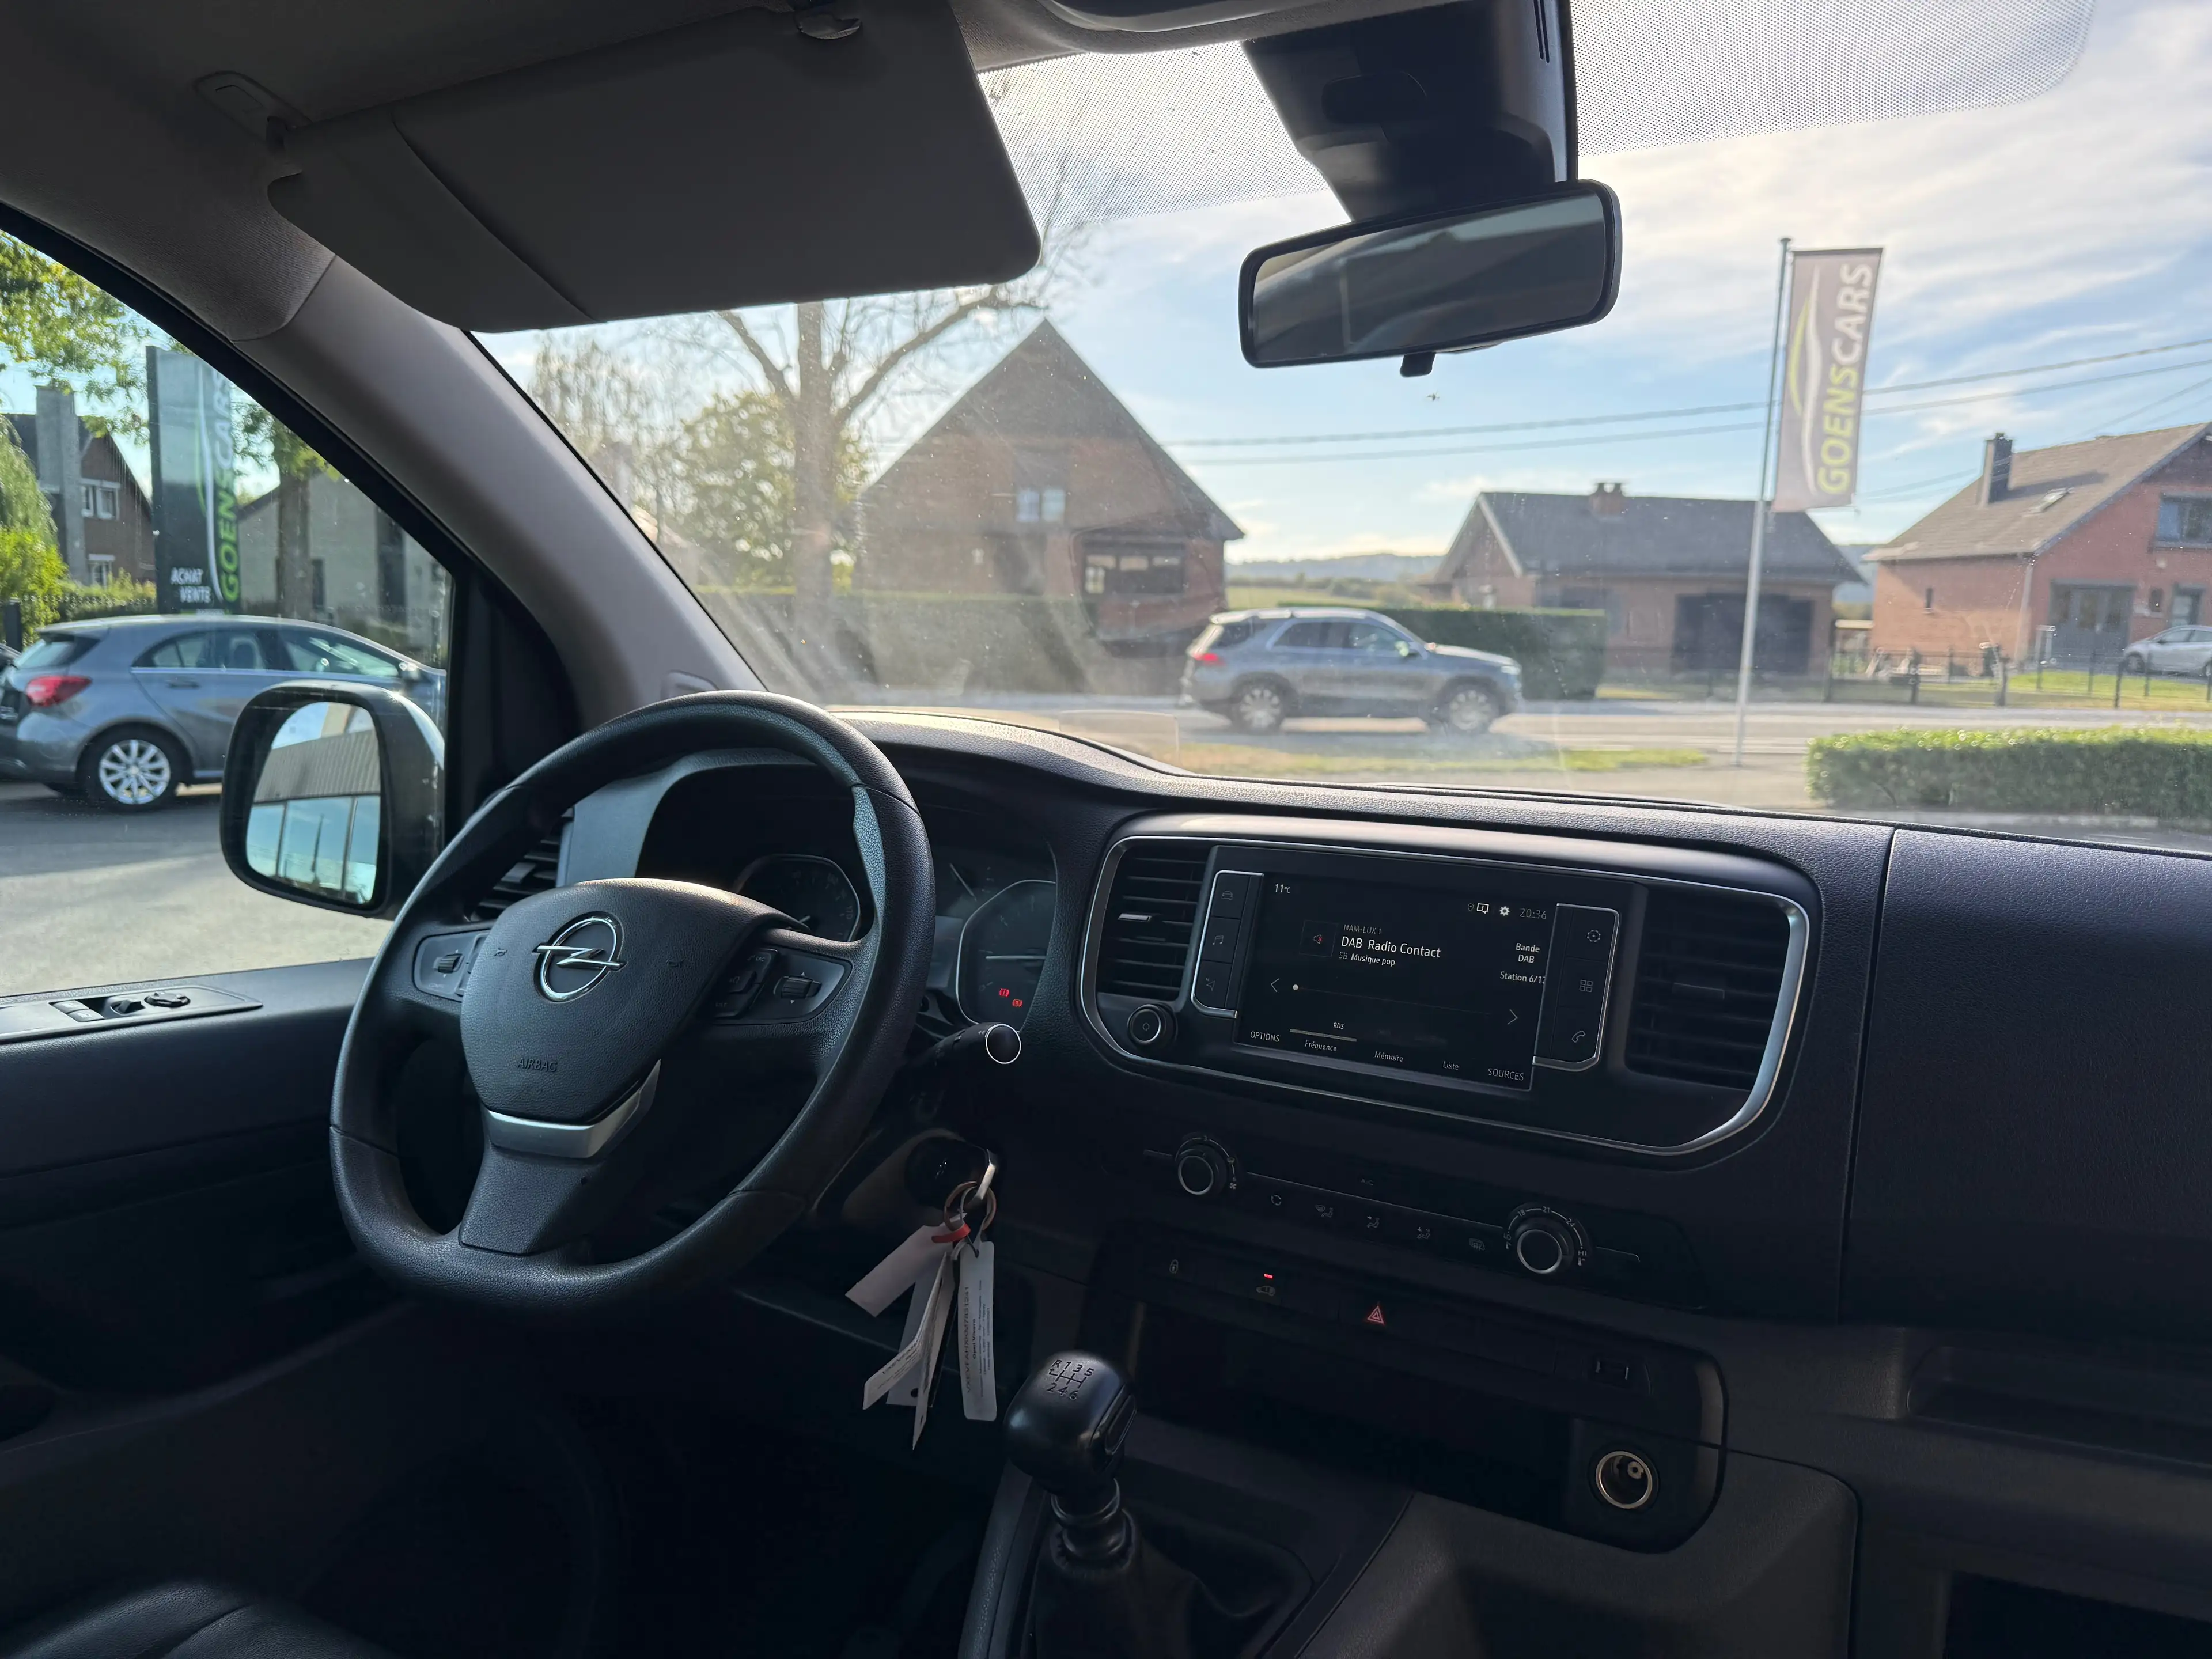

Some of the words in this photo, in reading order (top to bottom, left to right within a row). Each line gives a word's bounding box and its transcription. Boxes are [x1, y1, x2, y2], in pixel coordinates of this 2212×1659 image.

[1818, 263, 1873, 494] GOENSCARS
[1519, 908, 1547, 919] 20:36
[1343, 924, 1376, 934] NAM-LUX
[1341, 936, 1363, 949] DAB
[1368, 939, 1397, 953] Radio
[1400, 942, 1441, 958] Contact
[1516, 942, 1540, 953] Bande
[1351, 953, 1381, 964] Musique
[1381, 958, 1396, 966] pop
[1518, 954, 1535, 963] DAB
[1499, 971, 1527, 982] Station
[1249, 1031, 1280, 1042] OPTIONS
[1304, 1040, 1337, 1052] Fréquence
[1374, 1050, 1404, 1062] Mémoire
[517, 1059, 558, 1072] AIRBAG
[1442, 1060, 1460, 1071] Liste
[1487, 1067, 1524, 1081] SOURCES
[1542, 1206, 1551, 1214] 21
[1566, 1218, 1575, 1227] 24
[1051, 1359, 1062, 1368] R
[1065, 1361, 1071, 1369] 1
[1073, 1364, 1083, 1372] 3
[1084, 1368, 1094, 1377] 5
[1047, 1382, 1058, 1392] 2
[1058, 1387, 1068, 1395] 4
[1069, 1390, 1078, 1400] 6
